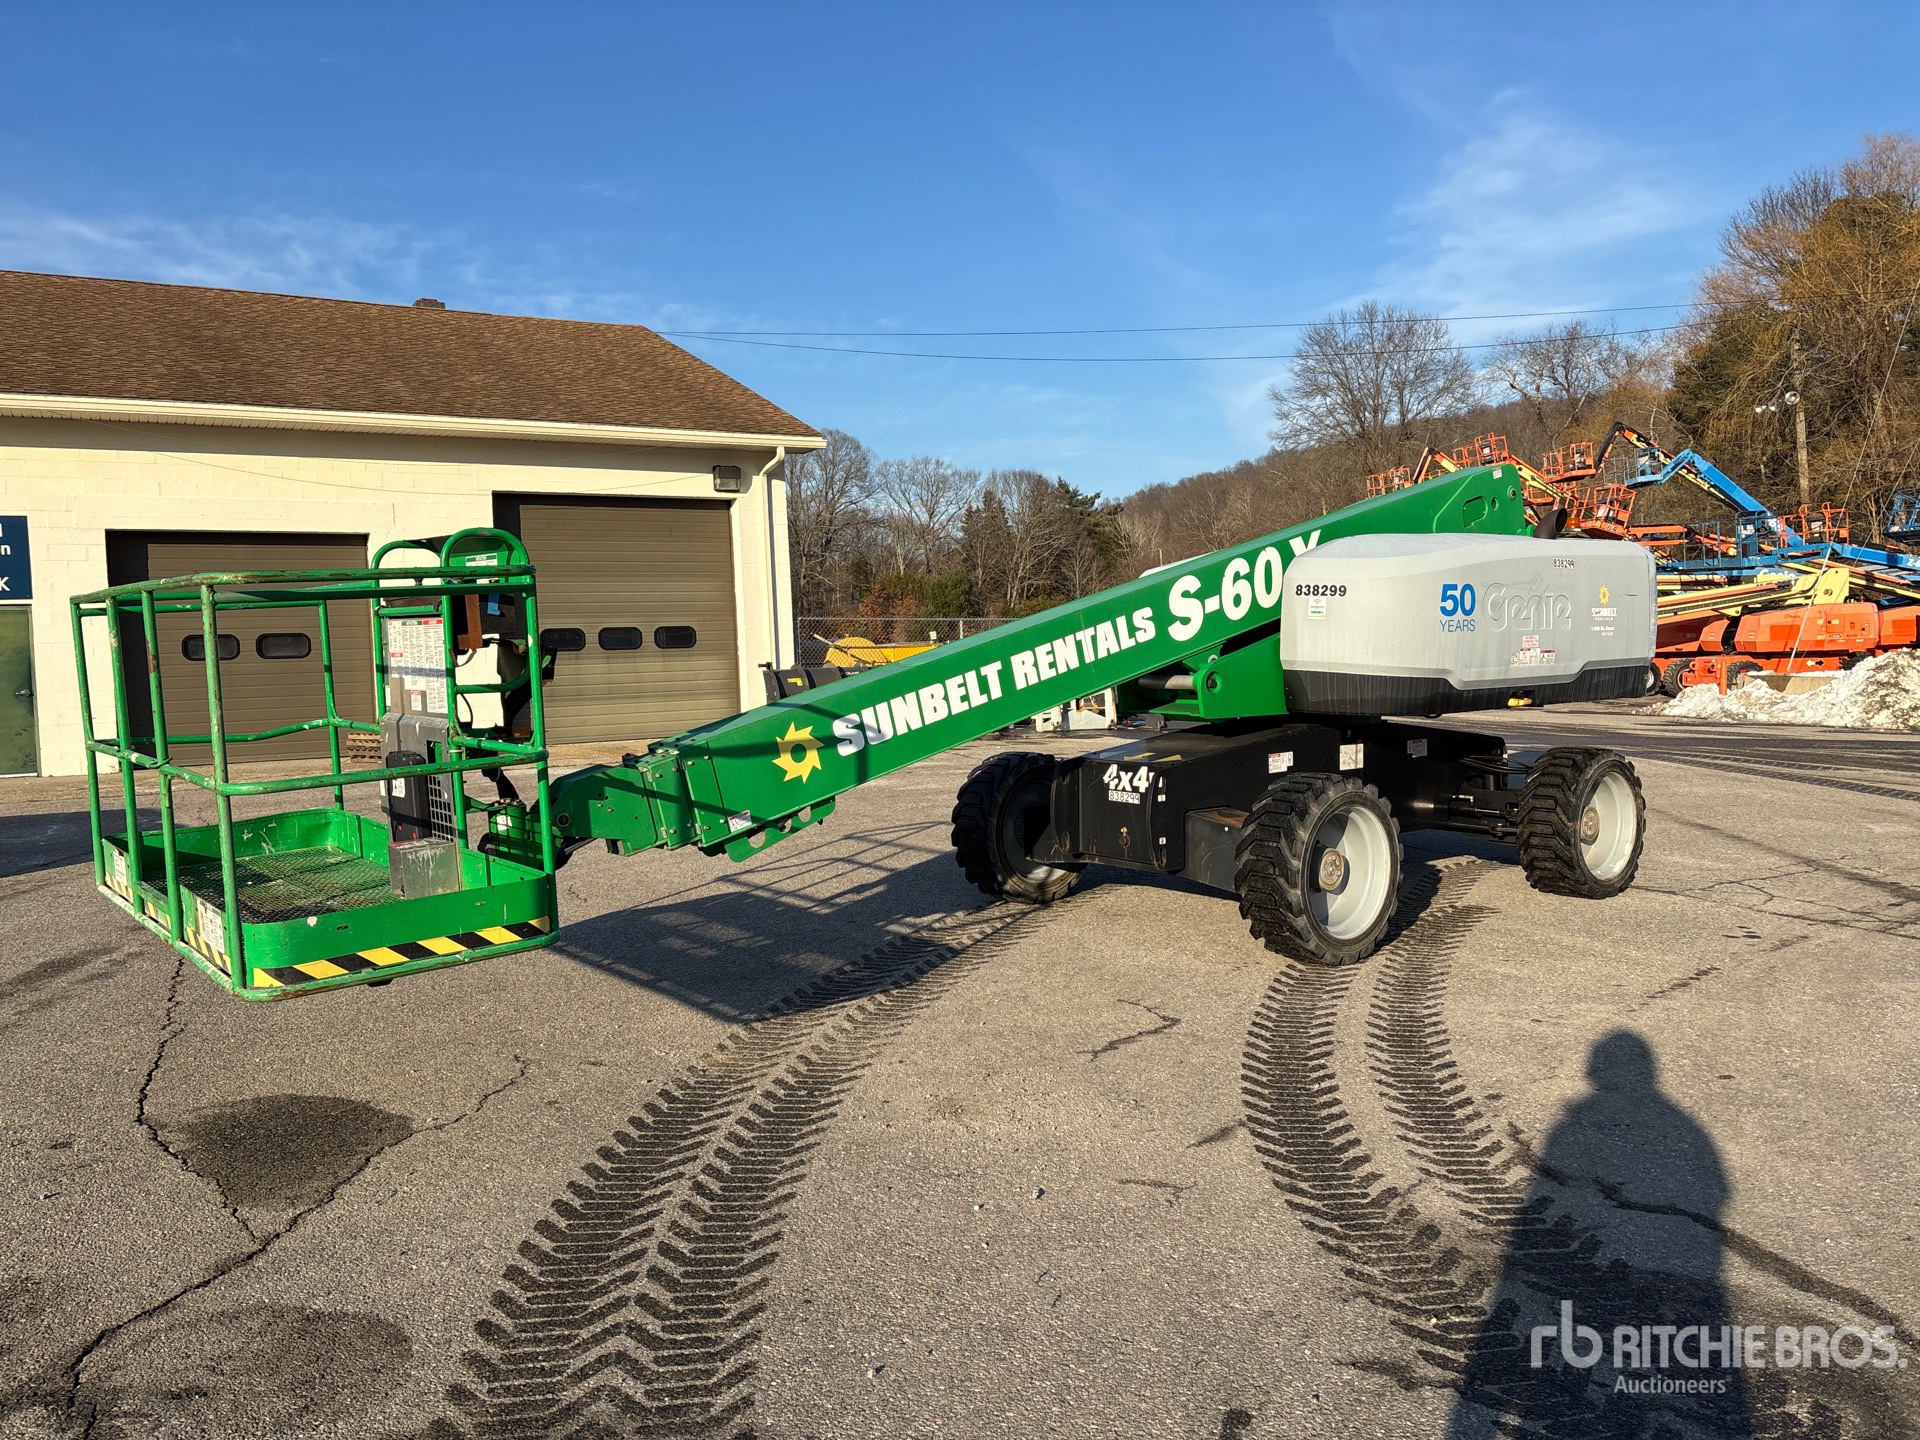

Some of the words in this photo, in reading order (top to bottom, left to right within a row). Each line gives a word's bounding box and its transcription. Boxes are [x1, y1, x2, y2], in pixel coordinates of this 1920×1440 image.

[1295, 584, 1347, 597] 838299
[1439, 583, 1476, 617] 50
[1482, 582, 1572, 632] Genie
[1439, 619, 1476, 632] YEARS
[832, 661, 1002, 756] SUNBELT
[1010, 607, 1156, 690] RENTALS
[1103, 764, 1149, 793] 4x4
[1109, 790, 1140, 803] 838299
